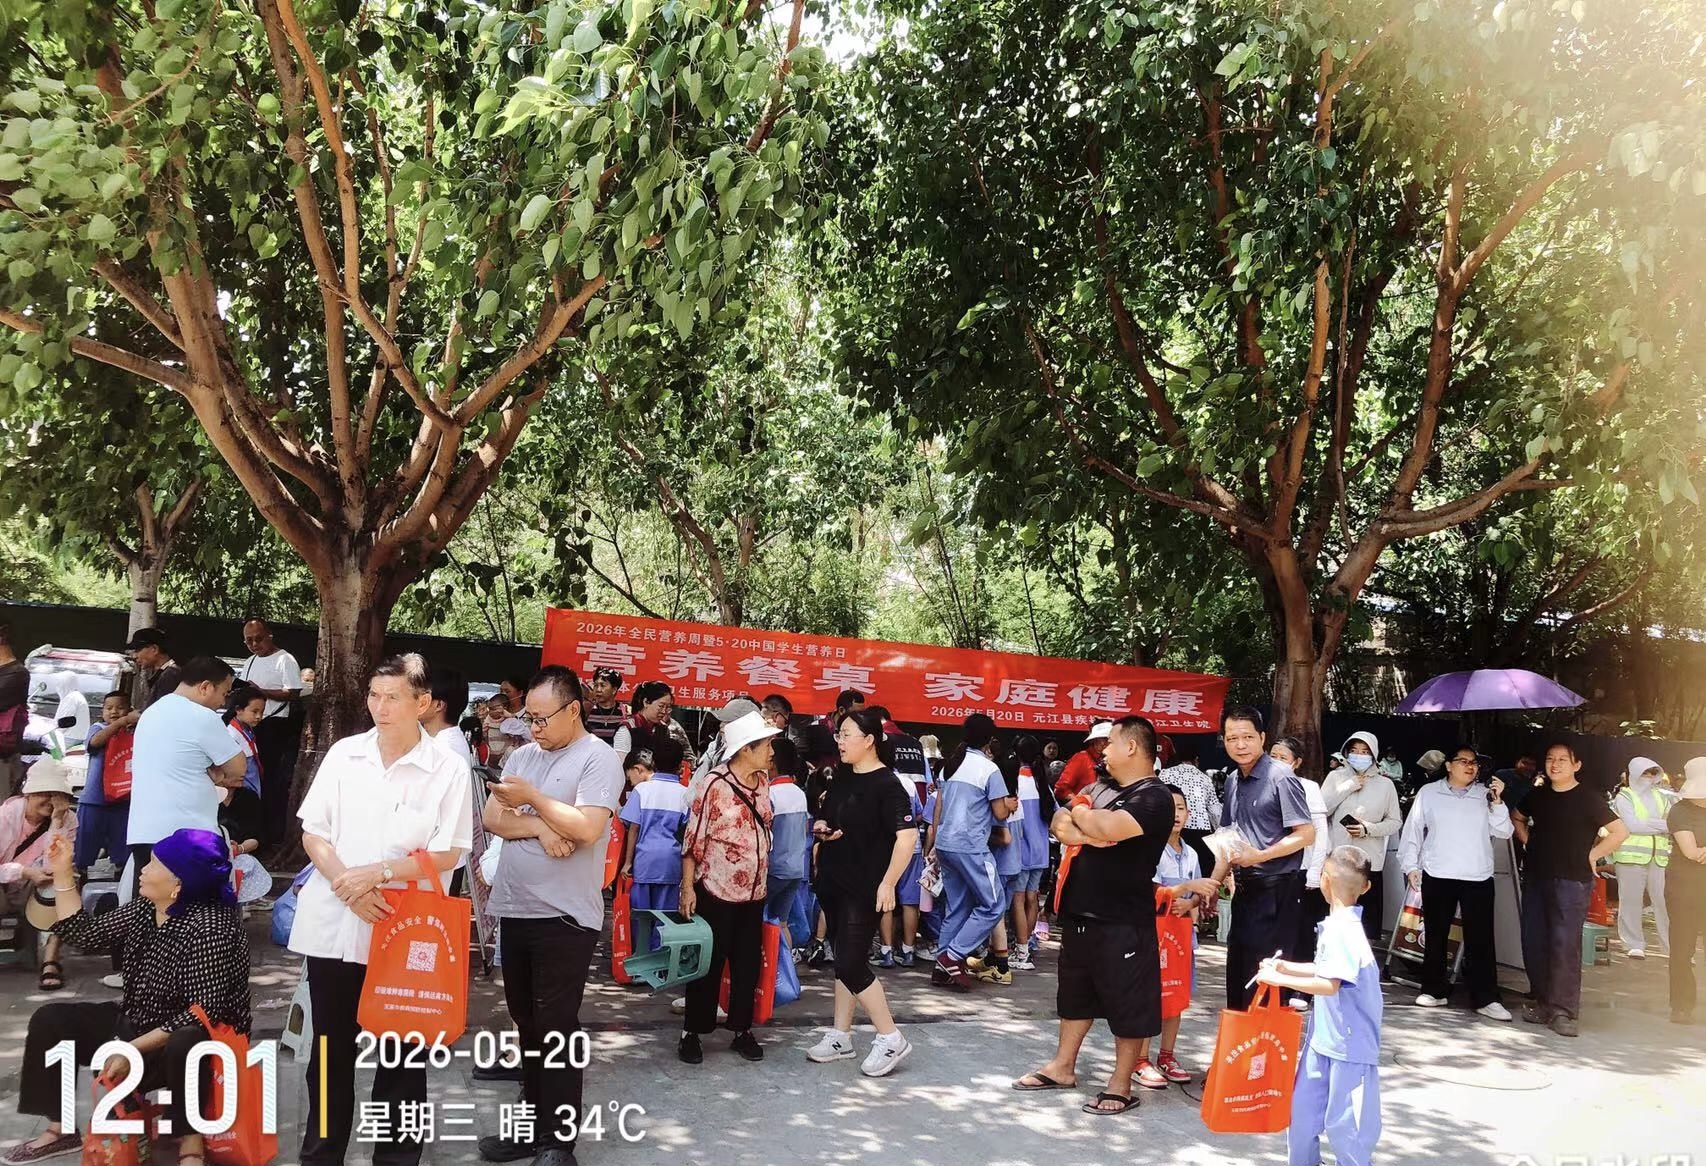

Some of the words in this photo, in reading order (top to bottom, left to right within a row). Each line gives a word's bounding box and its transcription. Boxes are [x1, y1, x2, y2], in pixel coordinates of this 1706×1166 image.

[575, 640, 876, 694] 营养餐桌
[924, 672, 1204, 716] 家庭健康
[831, 1041, 842, 1051] N
